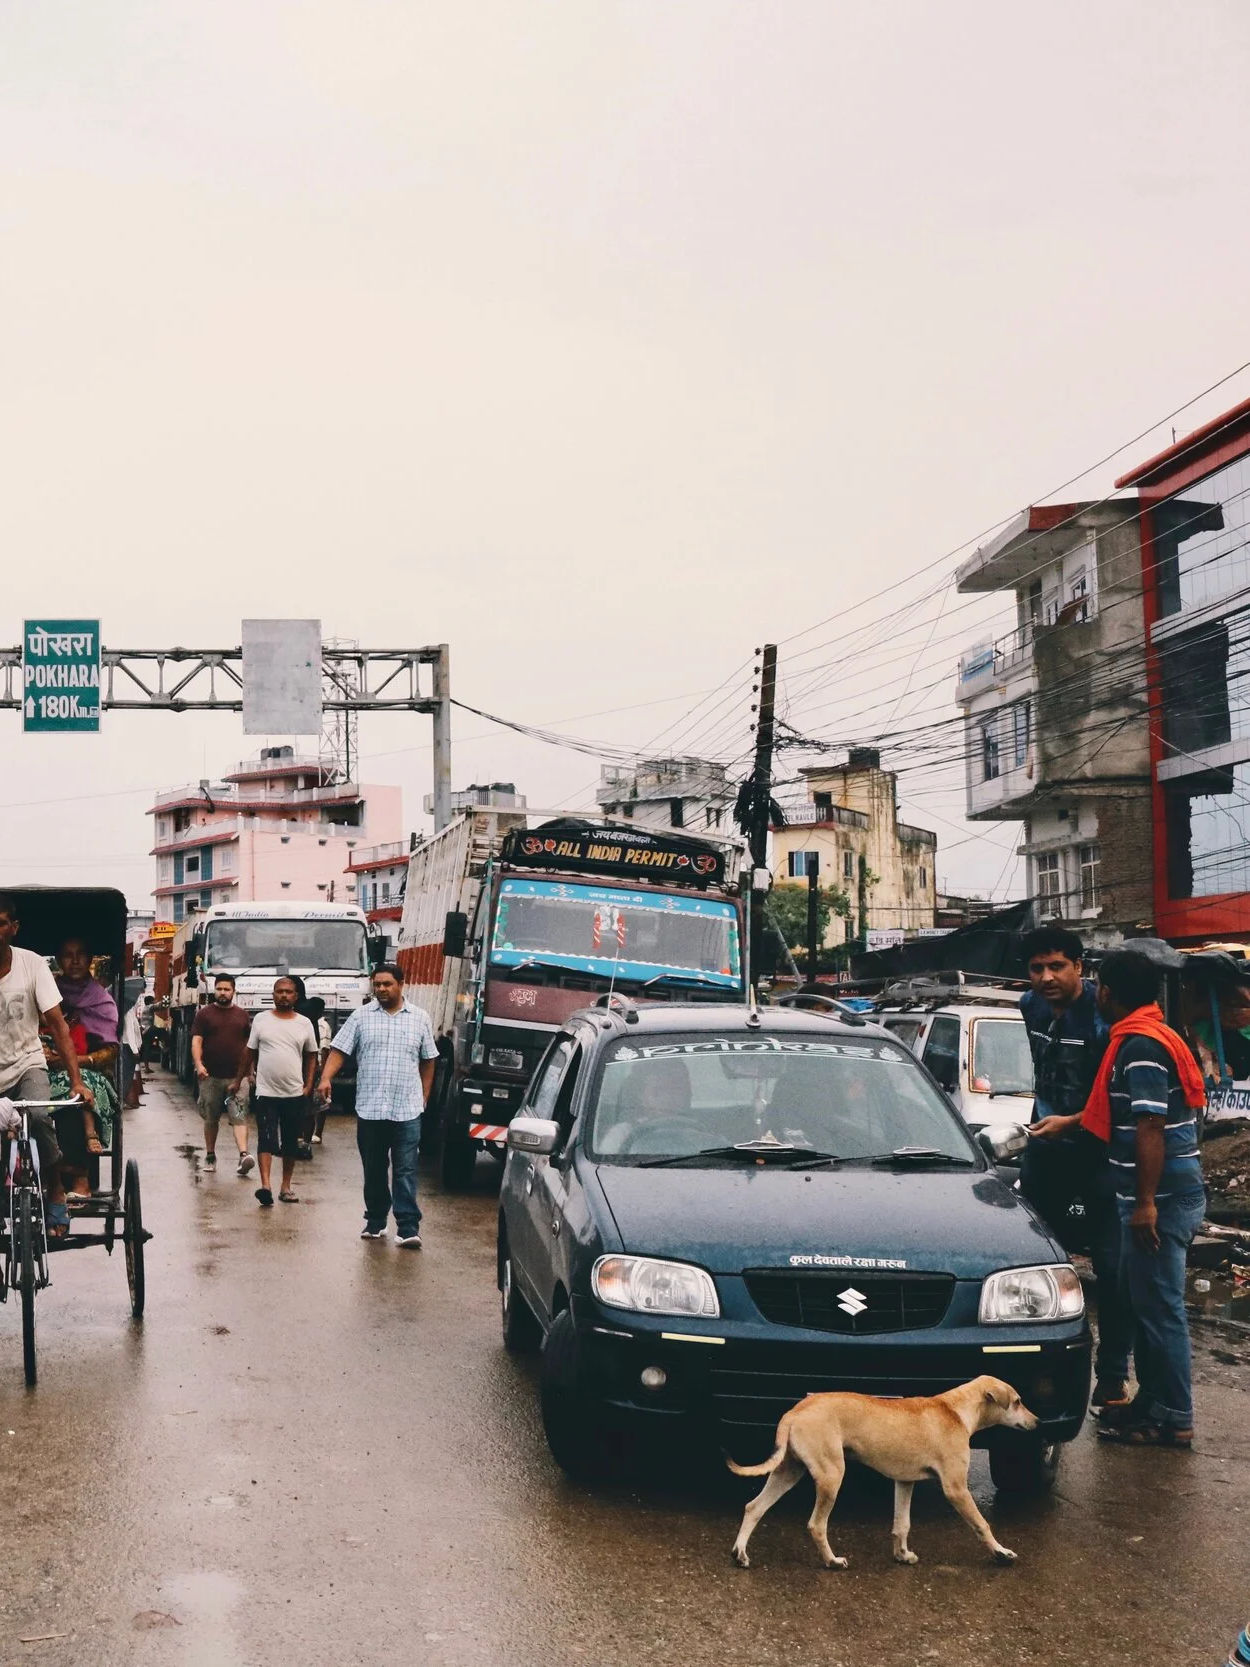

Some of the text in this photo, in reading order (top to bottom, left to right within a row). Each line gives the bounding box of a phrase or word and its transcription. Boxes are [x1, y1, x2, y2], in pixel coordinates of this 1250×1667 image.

[27, 626, 94, 656] पोखरा
[25, 664, 99, 688] POKHARA
[556, 841, 677, 868] ALL INDIA PERMIT
[790, 1254, 812, 1267] कुल
